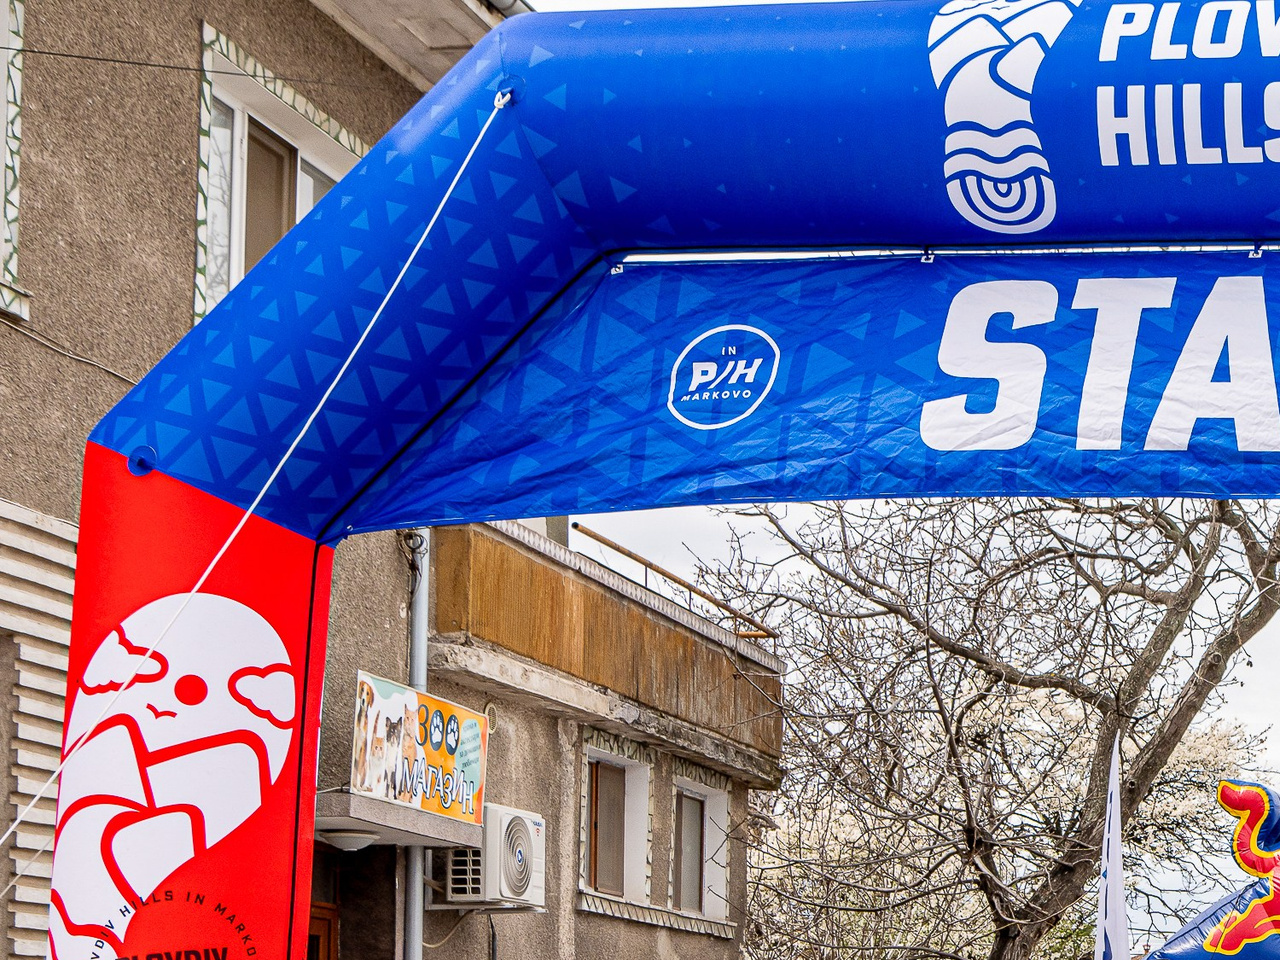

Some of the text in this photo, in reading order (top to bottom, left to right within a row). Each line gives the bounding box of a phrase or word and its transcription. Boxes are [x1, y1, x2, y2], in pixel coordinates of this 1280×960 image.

[721, 346, 737, 356] IN
[688, 358, 764, 392] P/H
[680, 389, 752, 402] MARKOVO
[401, 757, 474, 815] МАГАЗИН
[119, 890, 174, 918] HILLS
[186, 891, 206, 905] IN
